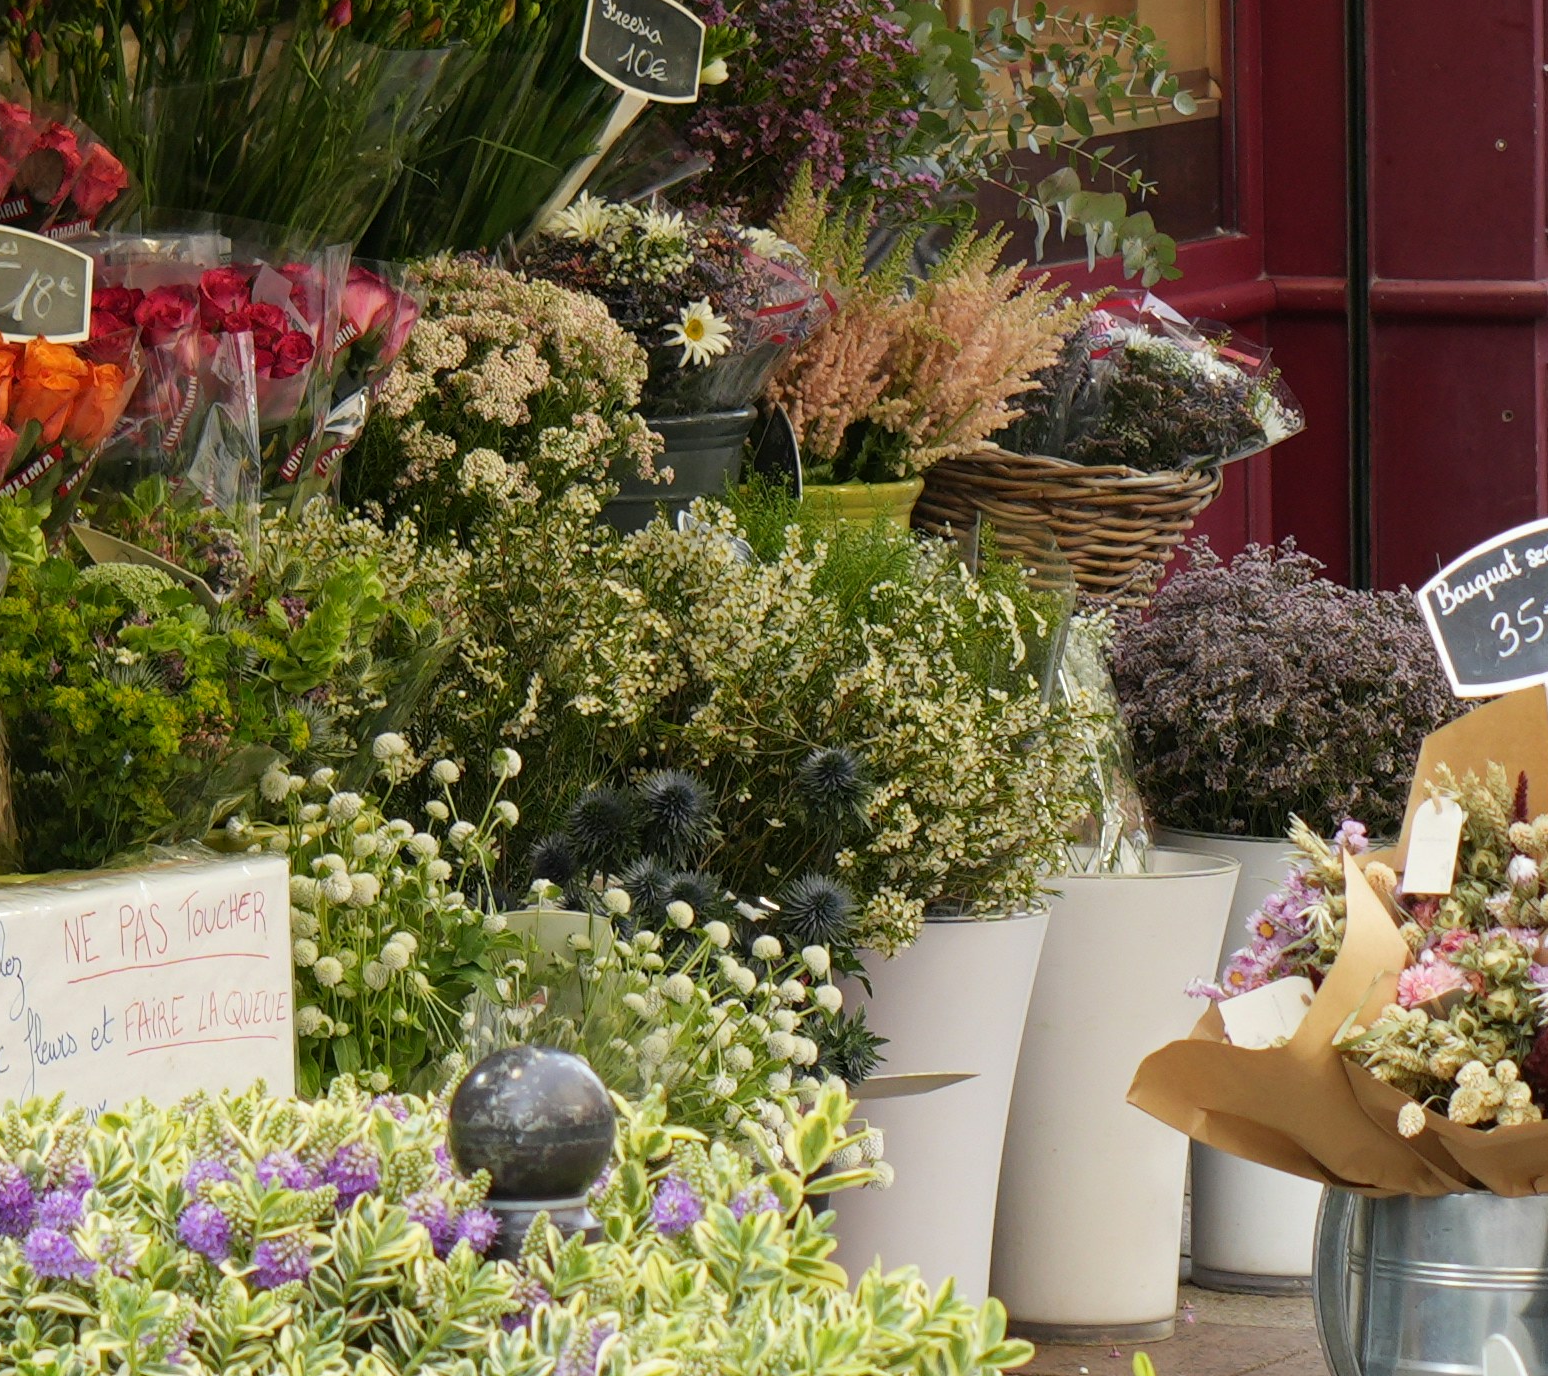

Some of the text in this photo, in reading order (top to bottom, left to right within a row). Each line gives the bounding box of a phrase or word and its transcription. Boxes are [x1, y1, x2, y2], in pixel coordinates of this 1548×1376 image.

[617, 43, 668, 82] 10€
[44, 220, 92, 240] LOMARIK
[164, 375, 198, 447] LOLOMARIK
[65, 912, 100, 963] NE
[120, 904, 168, 962] PAS
[179, 890, 267, 943] TOUCHER
[20, 1006, 77, 1109] fleurs
[91, 1005, 114, 1053] et
[125, 995, 184, 1043] FAIRE
[198, 994, 218, 1032] LA
[224, 991, 288, 1031] QUEUE
